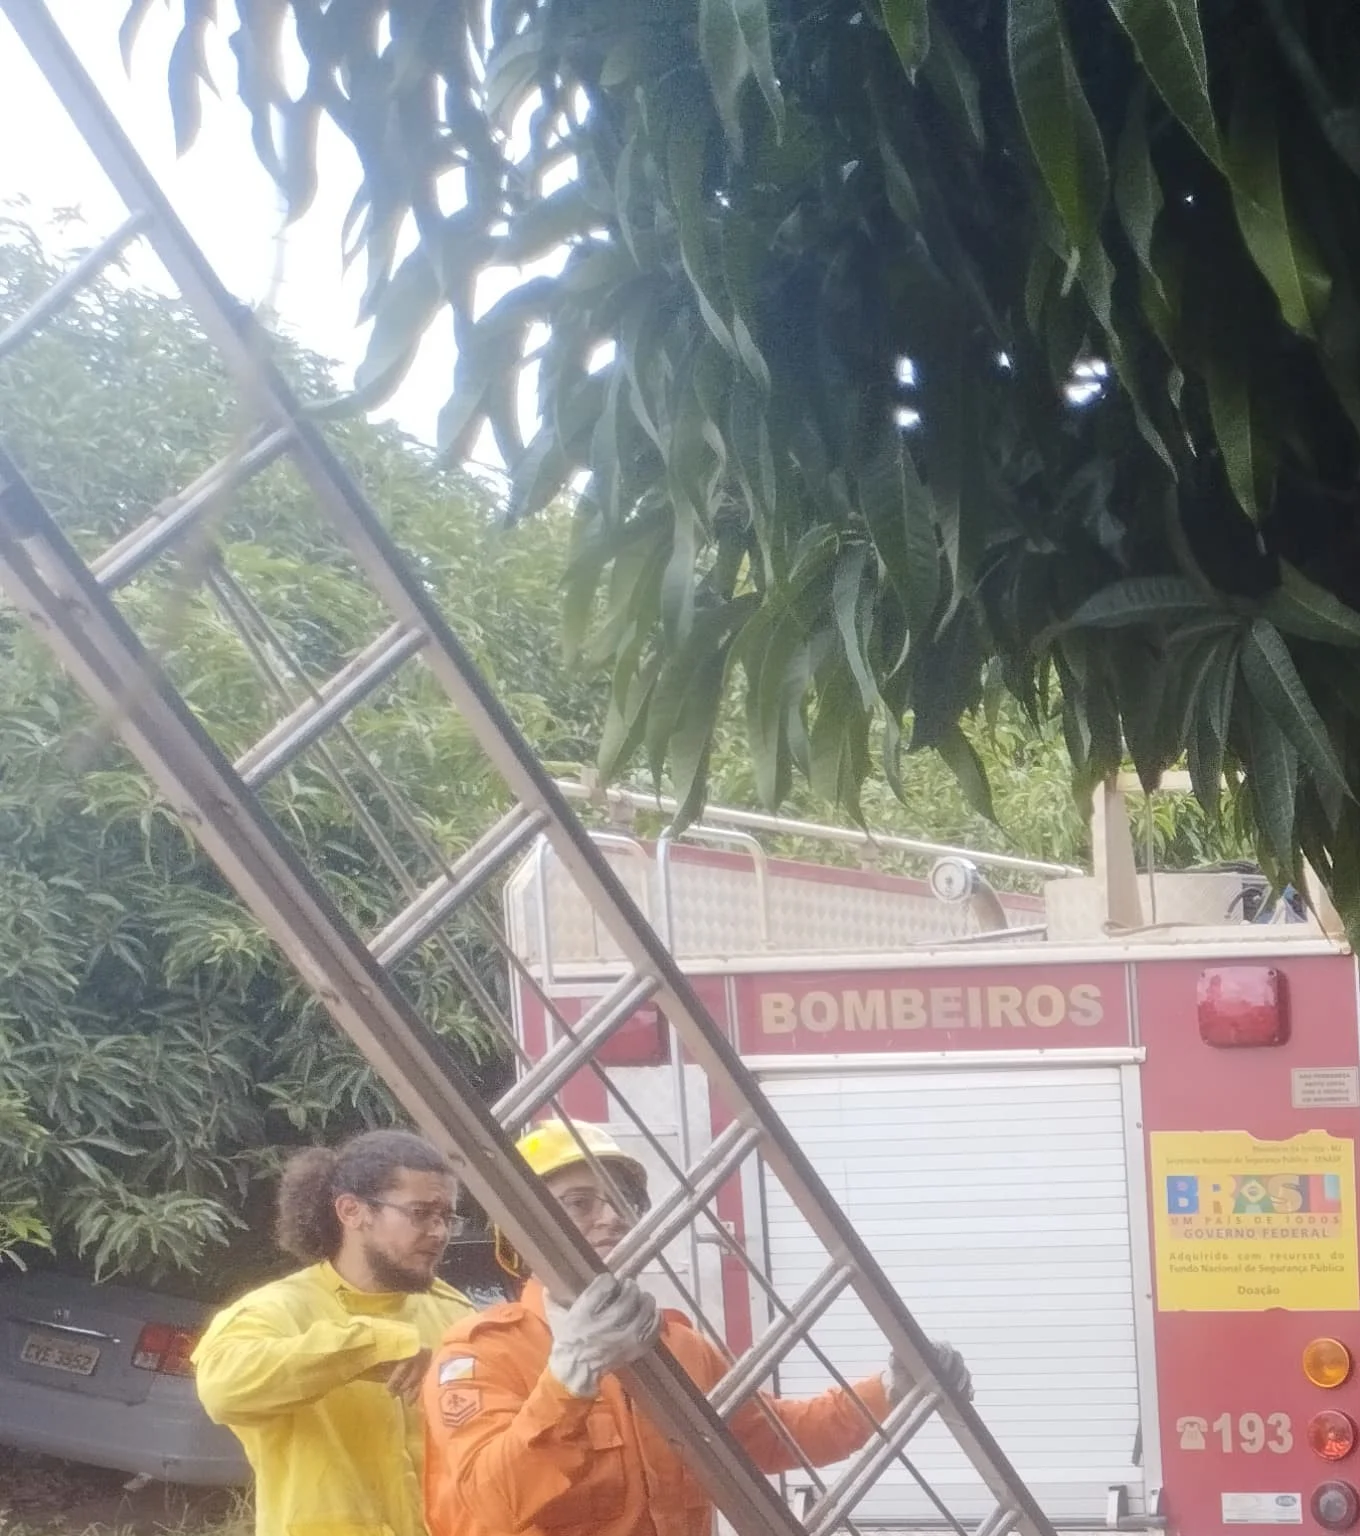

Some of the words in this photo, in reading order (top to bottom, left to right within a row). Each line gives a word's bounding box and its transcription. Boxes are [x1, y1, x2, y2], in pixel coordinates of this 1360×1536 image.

[760, 984, 1104, 1035] BOMBEIROS
[1167, 1174, 1342, 1214] BRASIL
[1171, 1217, 1193, 1225] UM
[1254, 1216, 1273, 1224] DE
[1285, 1215, 1340, 1224] TODOS
[1184, 1228, 1255, 1239] GOVERNO
[1263, 1227, 1329, 1238] FEDERAL
[1201, 1264, 1242, 1273] Nacional
[1244, 1264, 1256, 1272] de
[1237, 1284, 1281, 1296] Doação
[1213, 1412, 1293, 1454] 193
